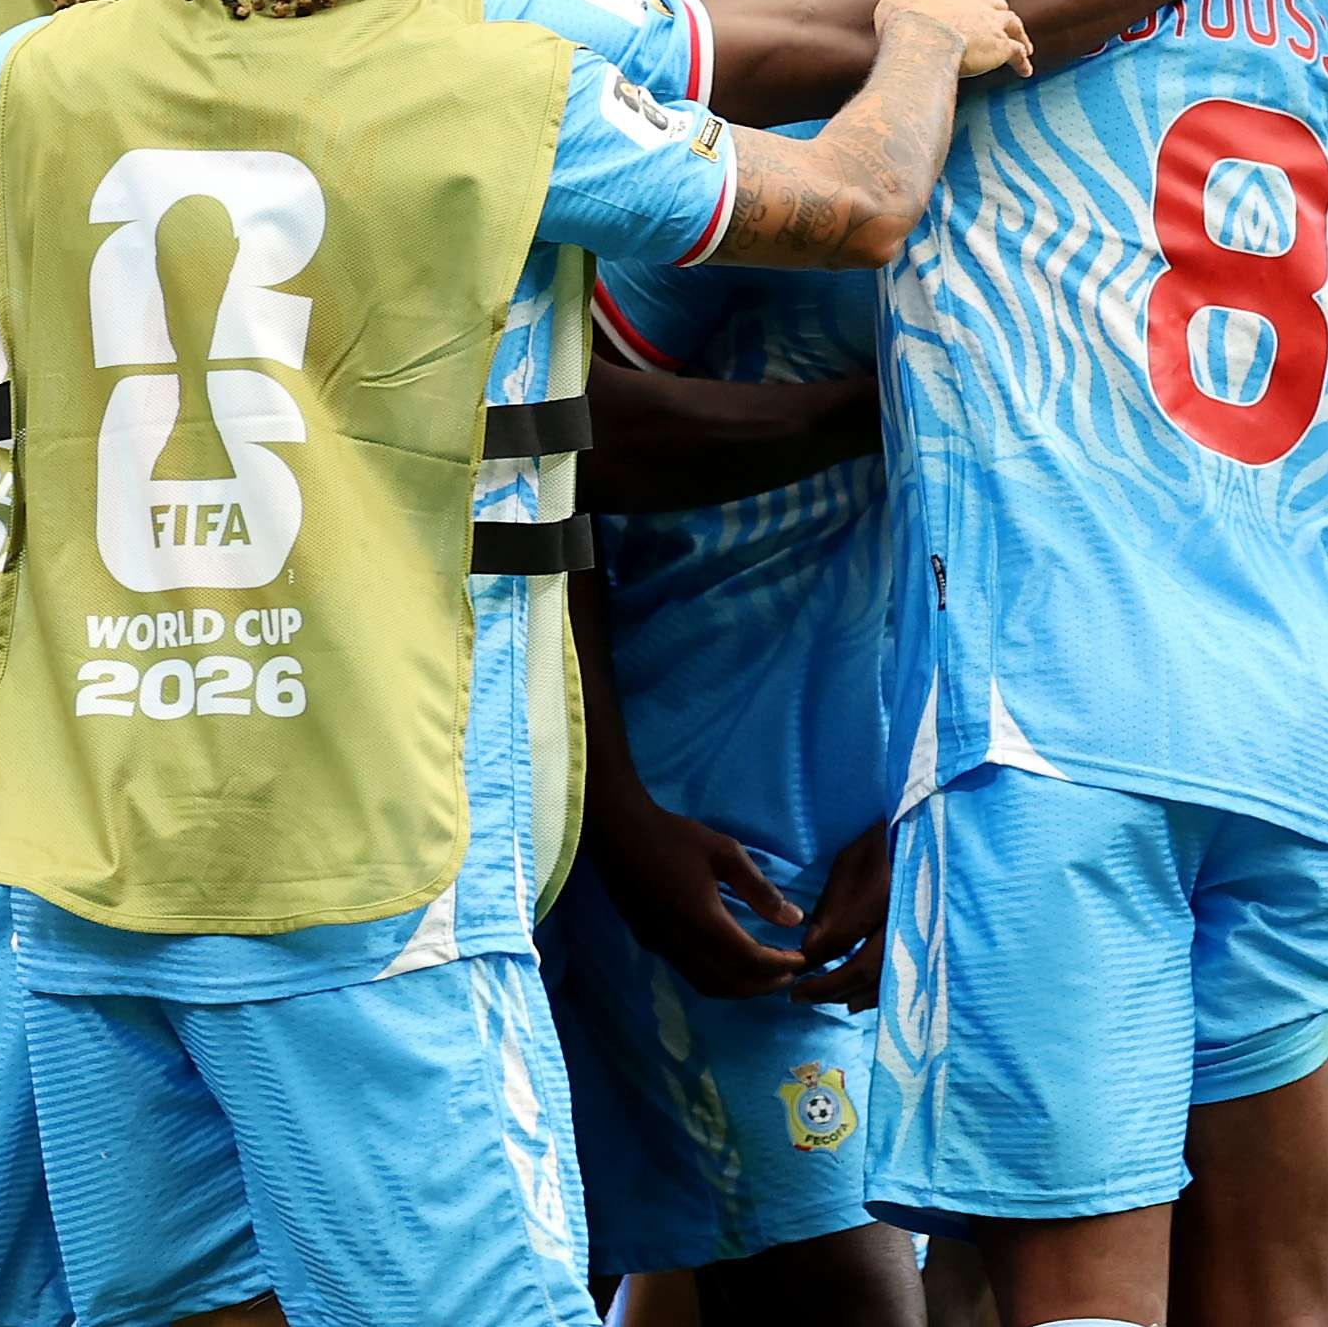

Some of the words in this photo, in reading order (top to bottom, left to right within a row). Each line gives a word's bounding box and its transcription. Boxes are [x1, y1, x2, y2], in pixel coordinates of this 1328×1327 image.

[150, 503, 252, 549] FIFA
[86, 608, 226, 652] WORLD
[234, 607, 303, 647] CUP
[75, 655, 307, 720] 2026
